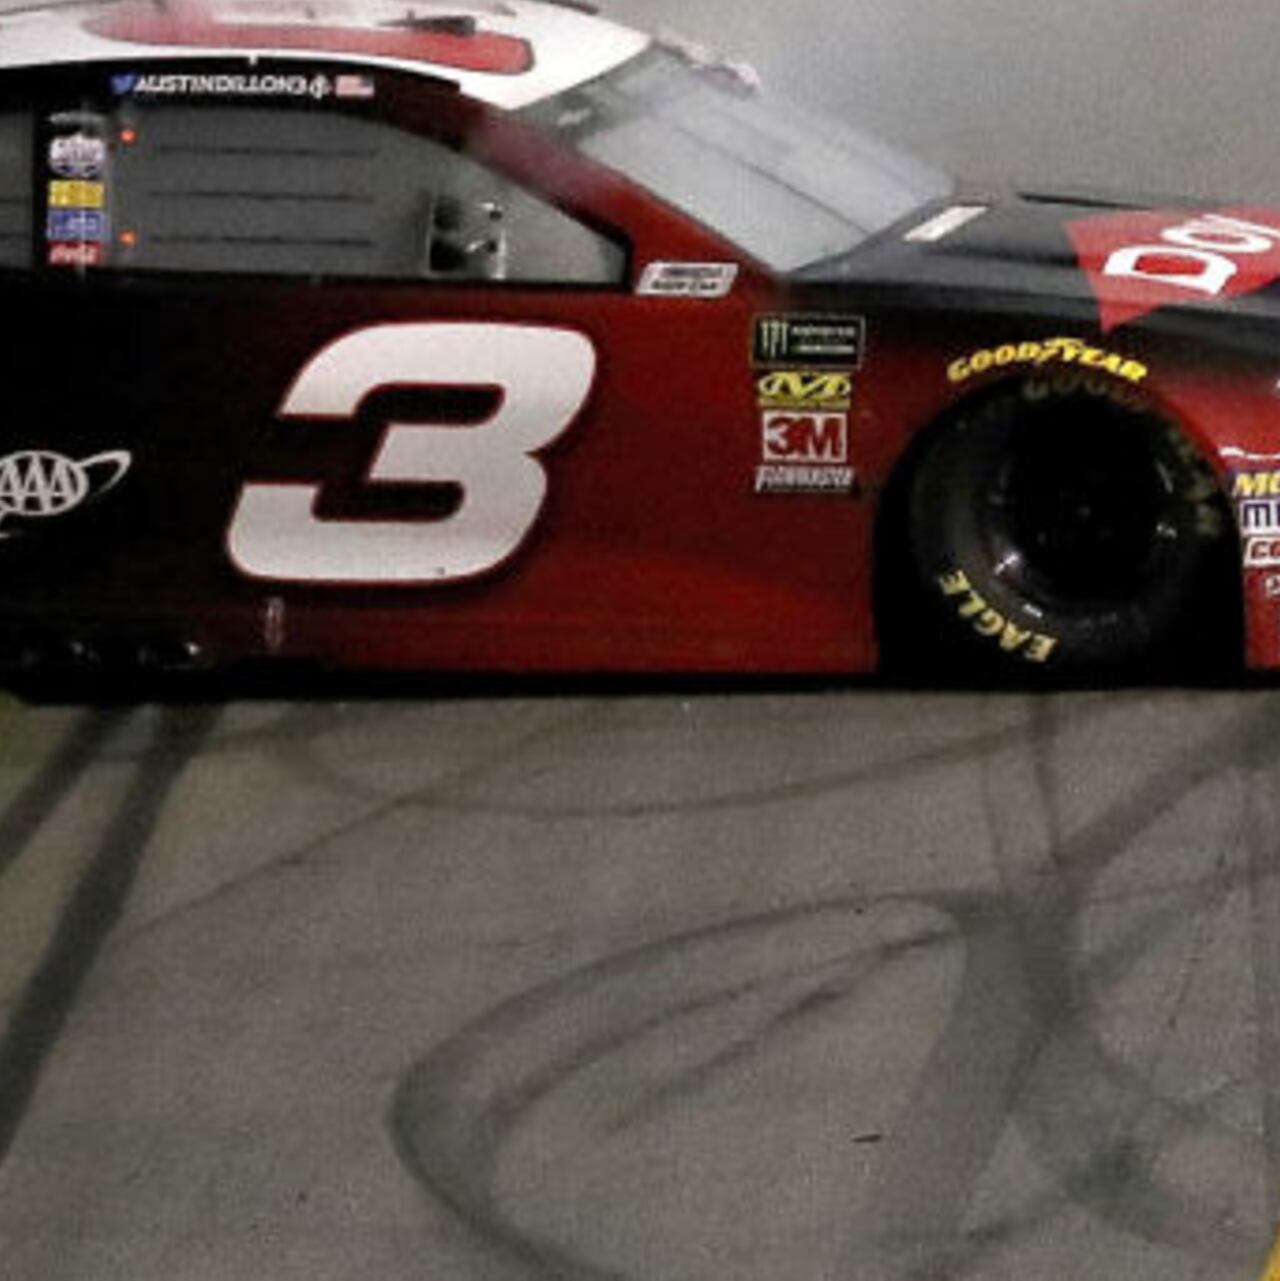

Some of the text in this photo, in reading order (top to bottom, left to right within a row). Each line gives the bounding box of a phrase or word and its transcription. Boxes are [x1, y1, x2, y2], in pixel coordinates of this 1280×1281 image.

[946, 337, 1148, 382] GOODYEAR
[227, 321, 597, 584] 3
[766, 417, 842, 457] 3M
[937, 570, 1058, 662] EAGLE
